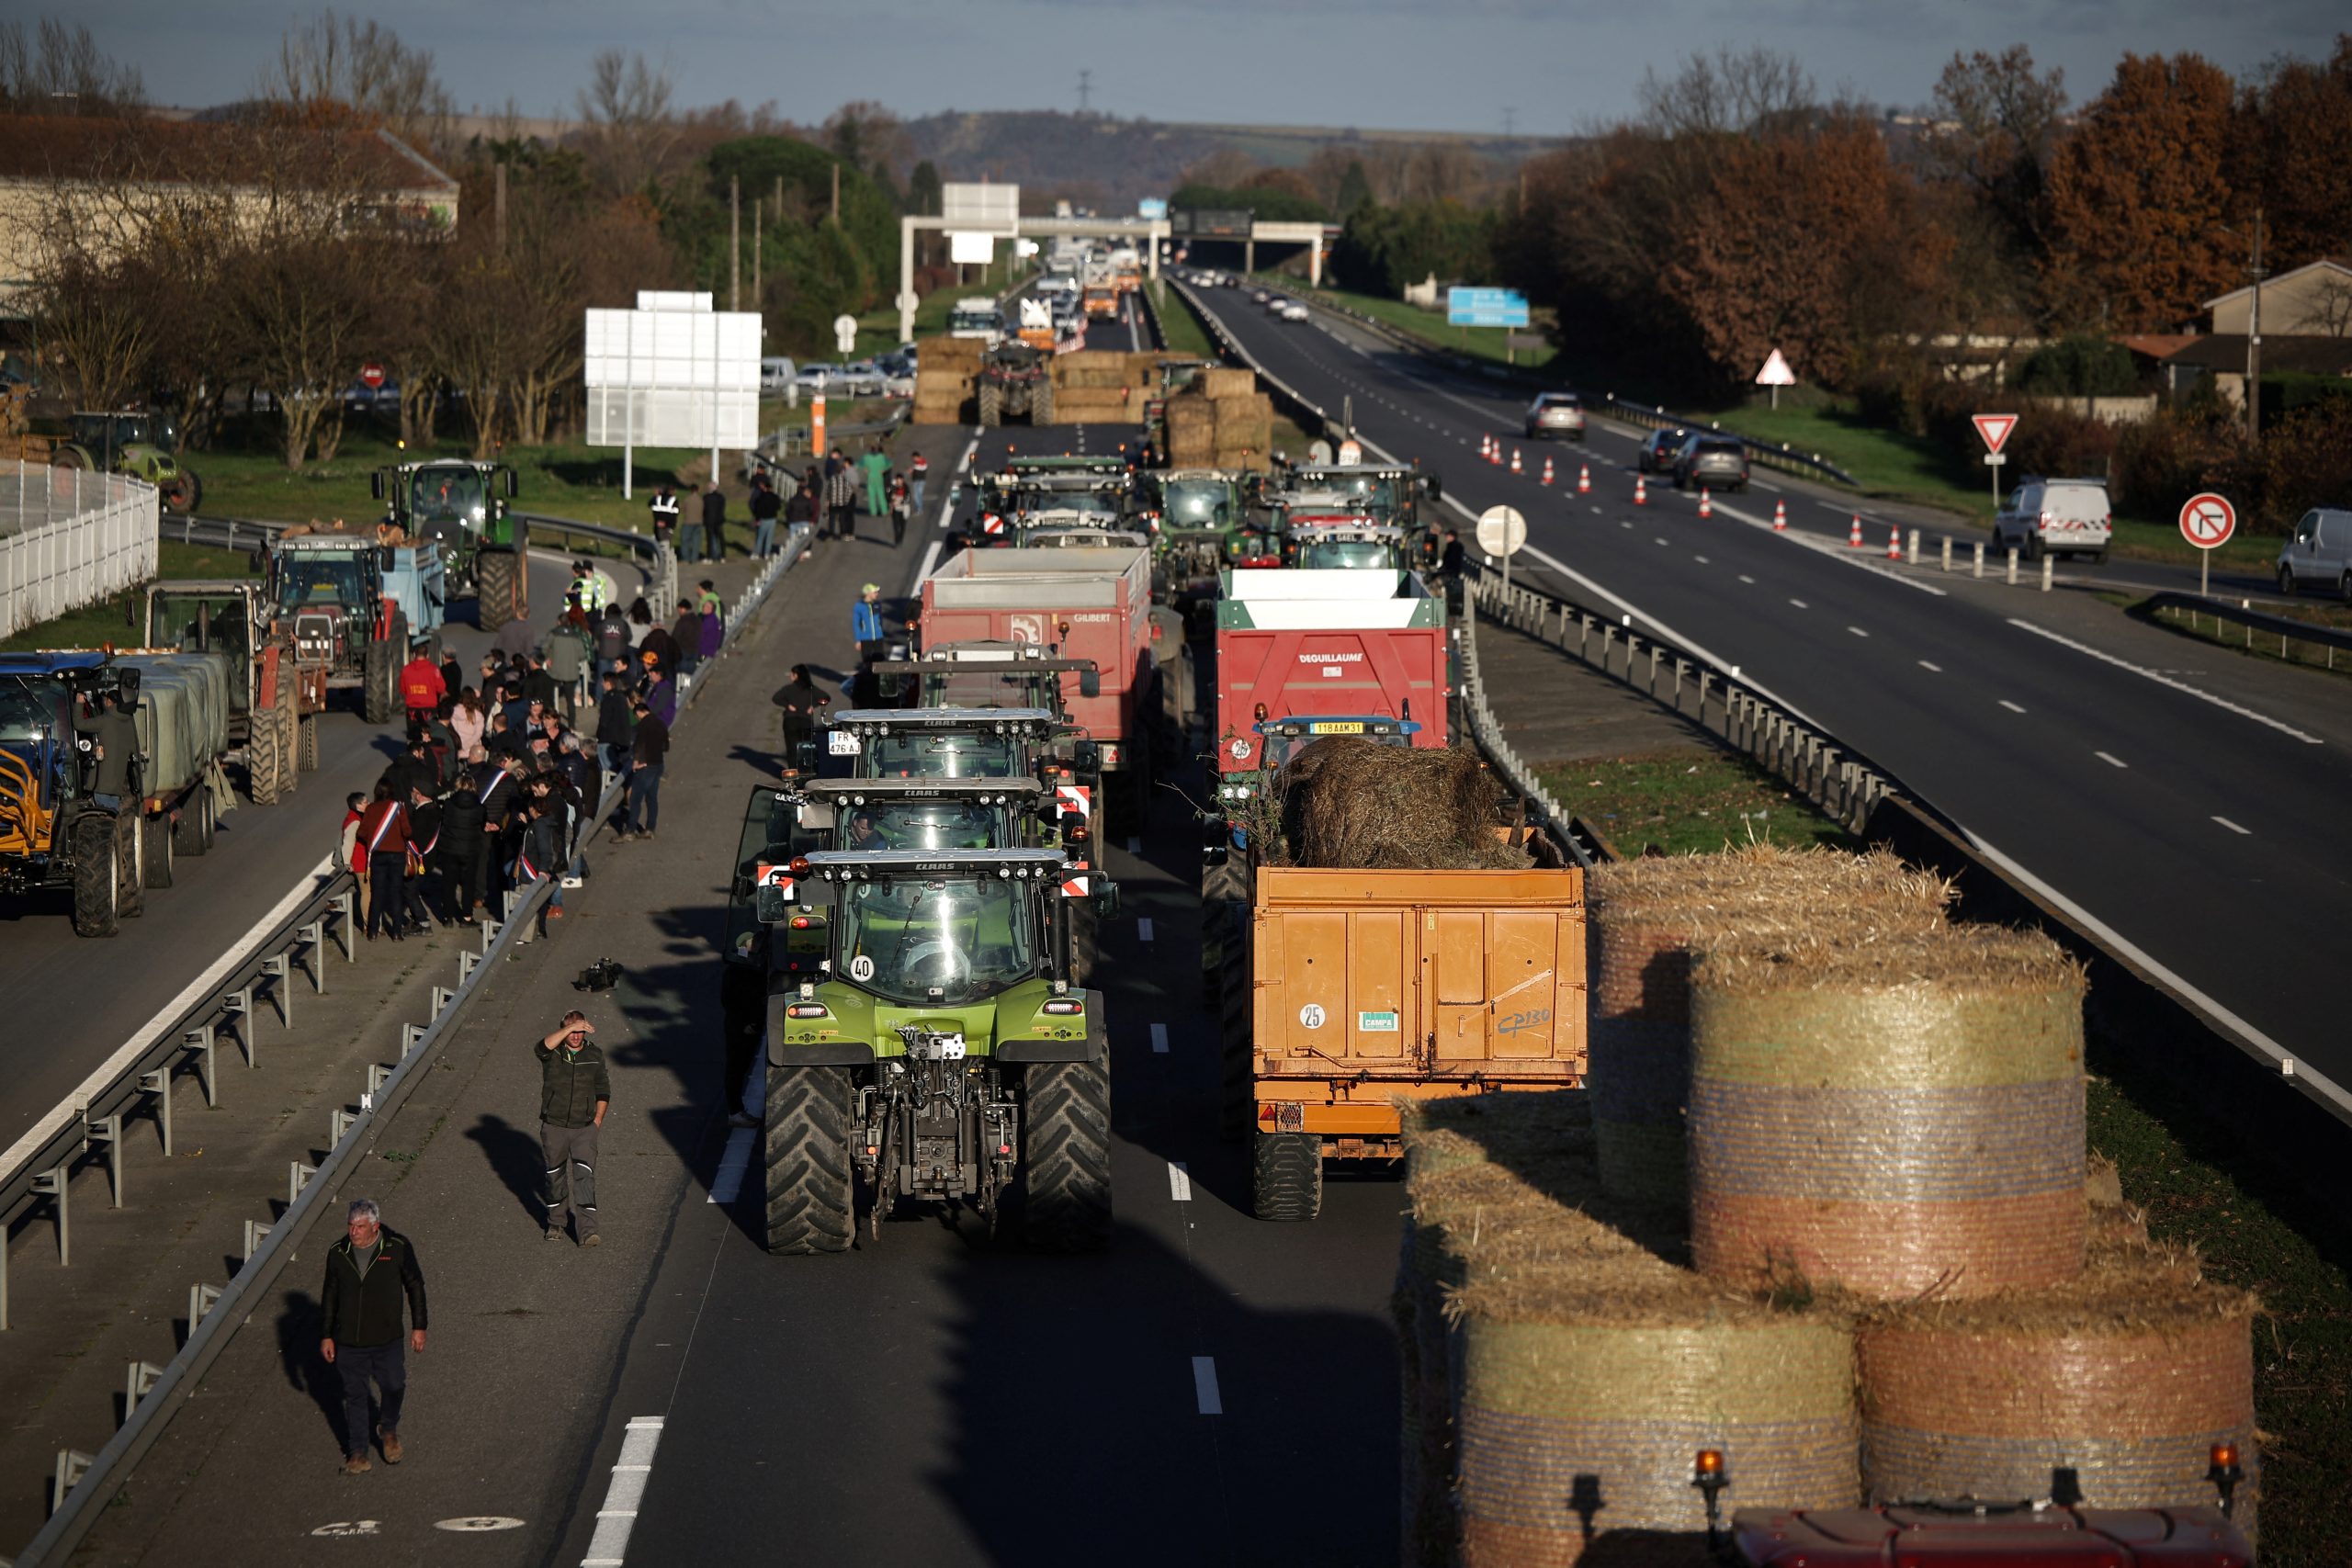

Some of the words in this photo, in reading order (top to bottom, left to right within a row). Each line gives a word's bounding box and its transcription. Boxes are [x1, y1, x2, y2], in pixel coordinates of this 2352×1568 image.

[1074, 614, 1111, 623] GILIBERT
[1299, 653, 1363, 663] DEGUILLAUME
[837, 734, 849, 742] FR
[830, 744, 846, 753] 476
[915, 863, 956, 871] CLAAS
[854, 960, 869, 977] 40
[1305, 1006, 1319, 1027] 25
[1365, 1019, 1393, 1027] CAMPA
